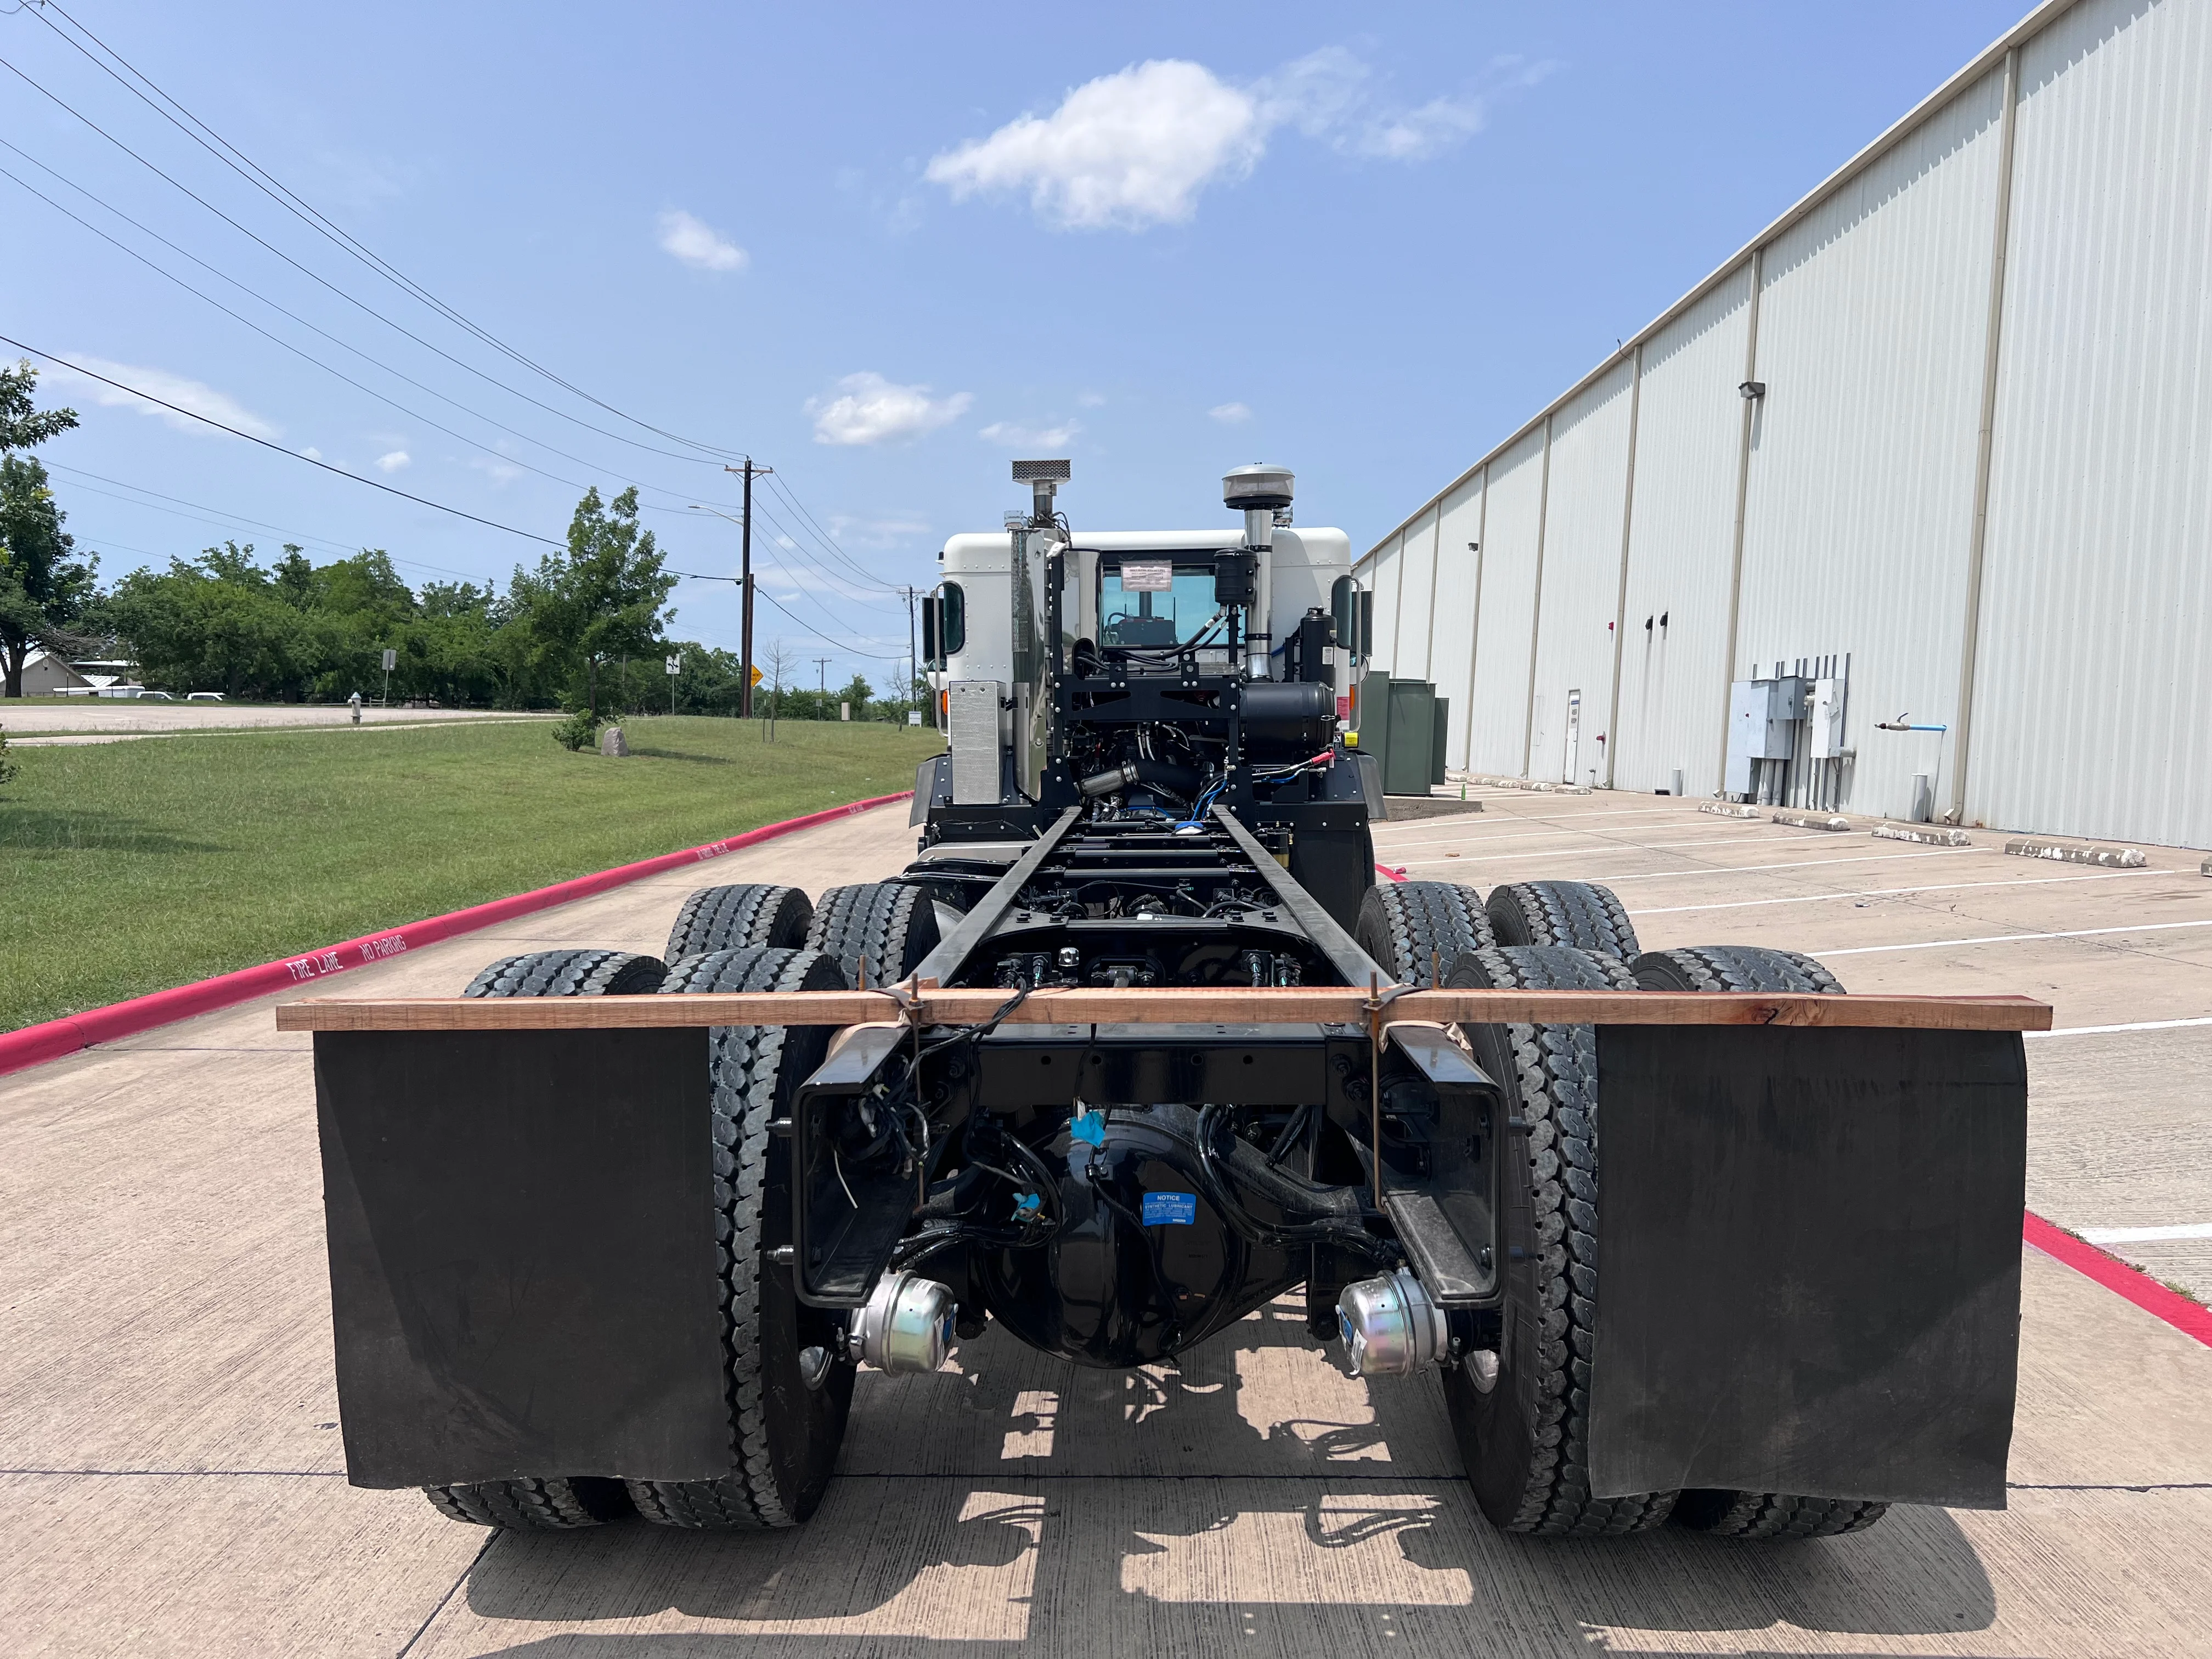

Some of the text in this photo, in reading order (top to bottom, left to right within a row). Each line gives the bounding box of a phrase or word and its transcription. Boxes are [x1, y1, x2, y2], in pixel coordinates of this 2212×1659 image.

[285, 934, 407, 980] FIRE LANE NO PARKING
